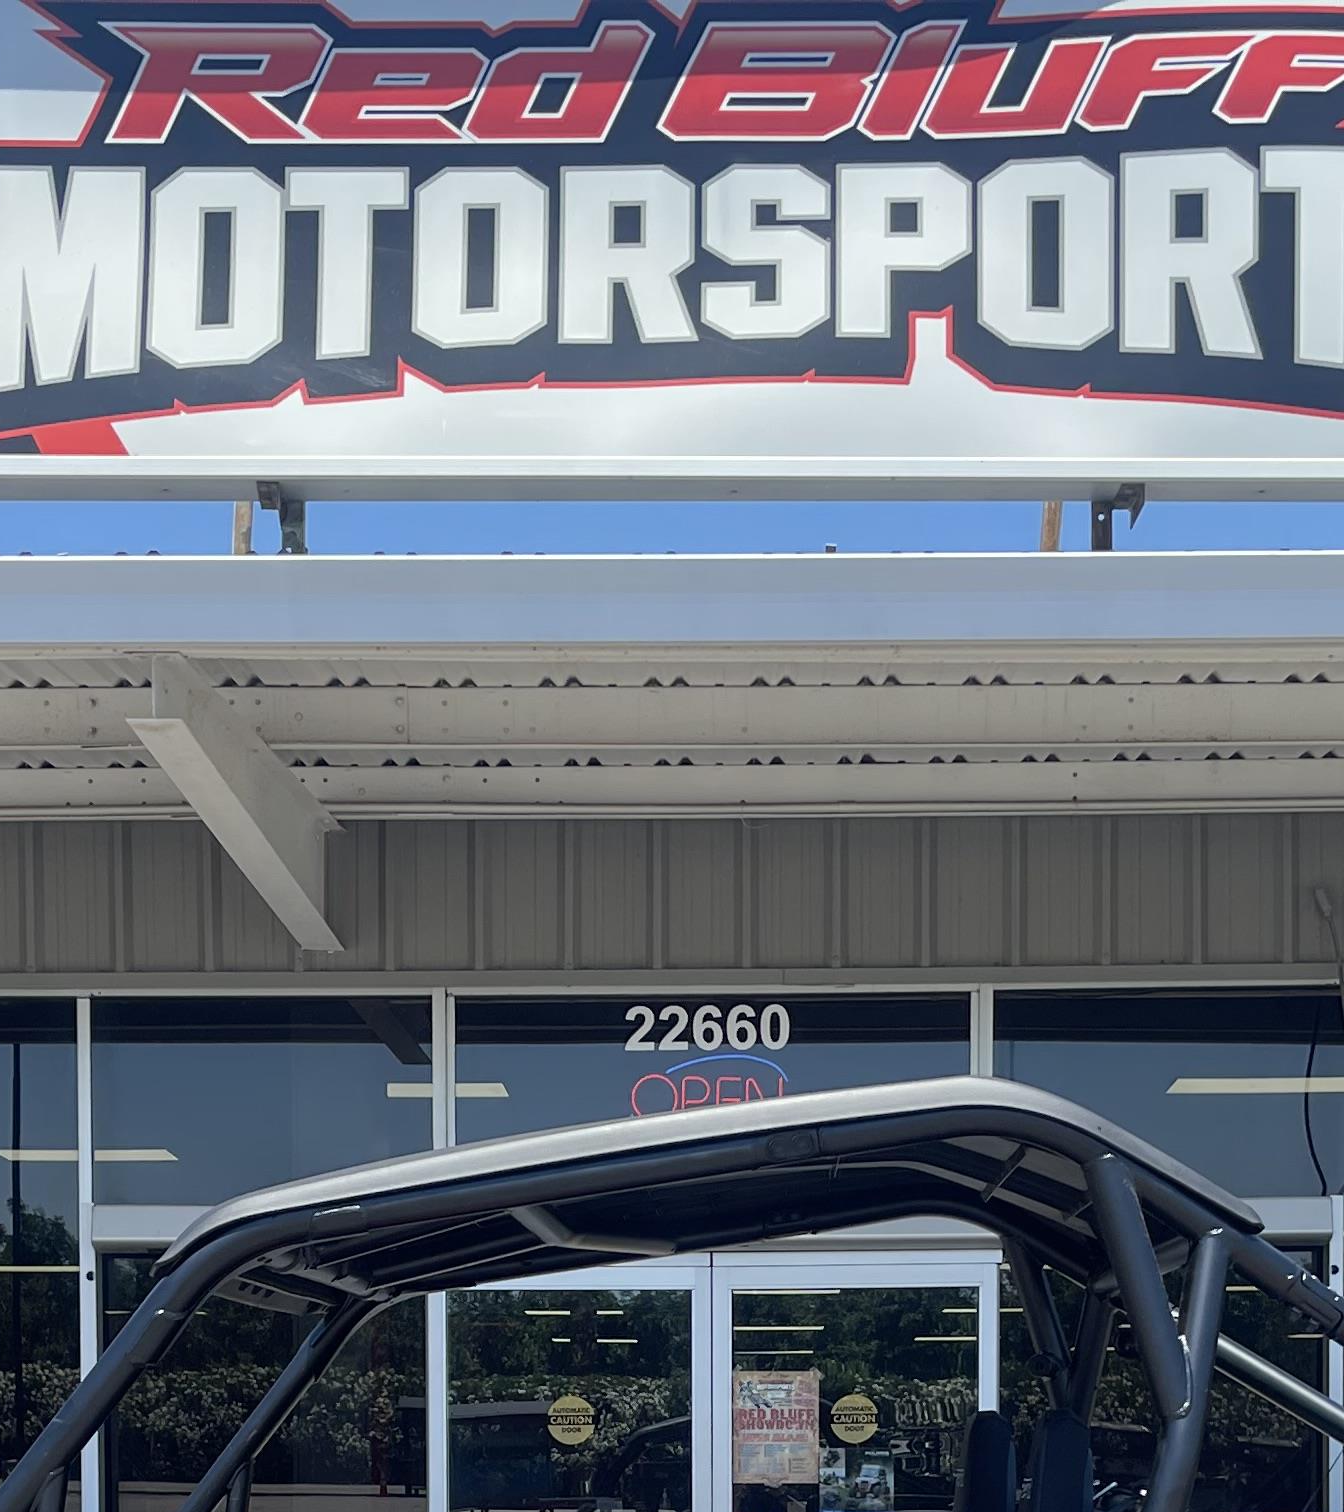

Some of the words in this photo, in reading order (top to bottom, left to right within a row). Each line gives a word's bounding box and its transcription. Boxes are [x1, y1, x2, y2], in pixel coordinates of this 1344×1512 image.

[100, 20, 656, 144] Red
[624, 1004, 791, 1051] 22660
[549, 1416, 593, 1425] CAUTION
[833, 1414, 876, 1424] CAUTION
